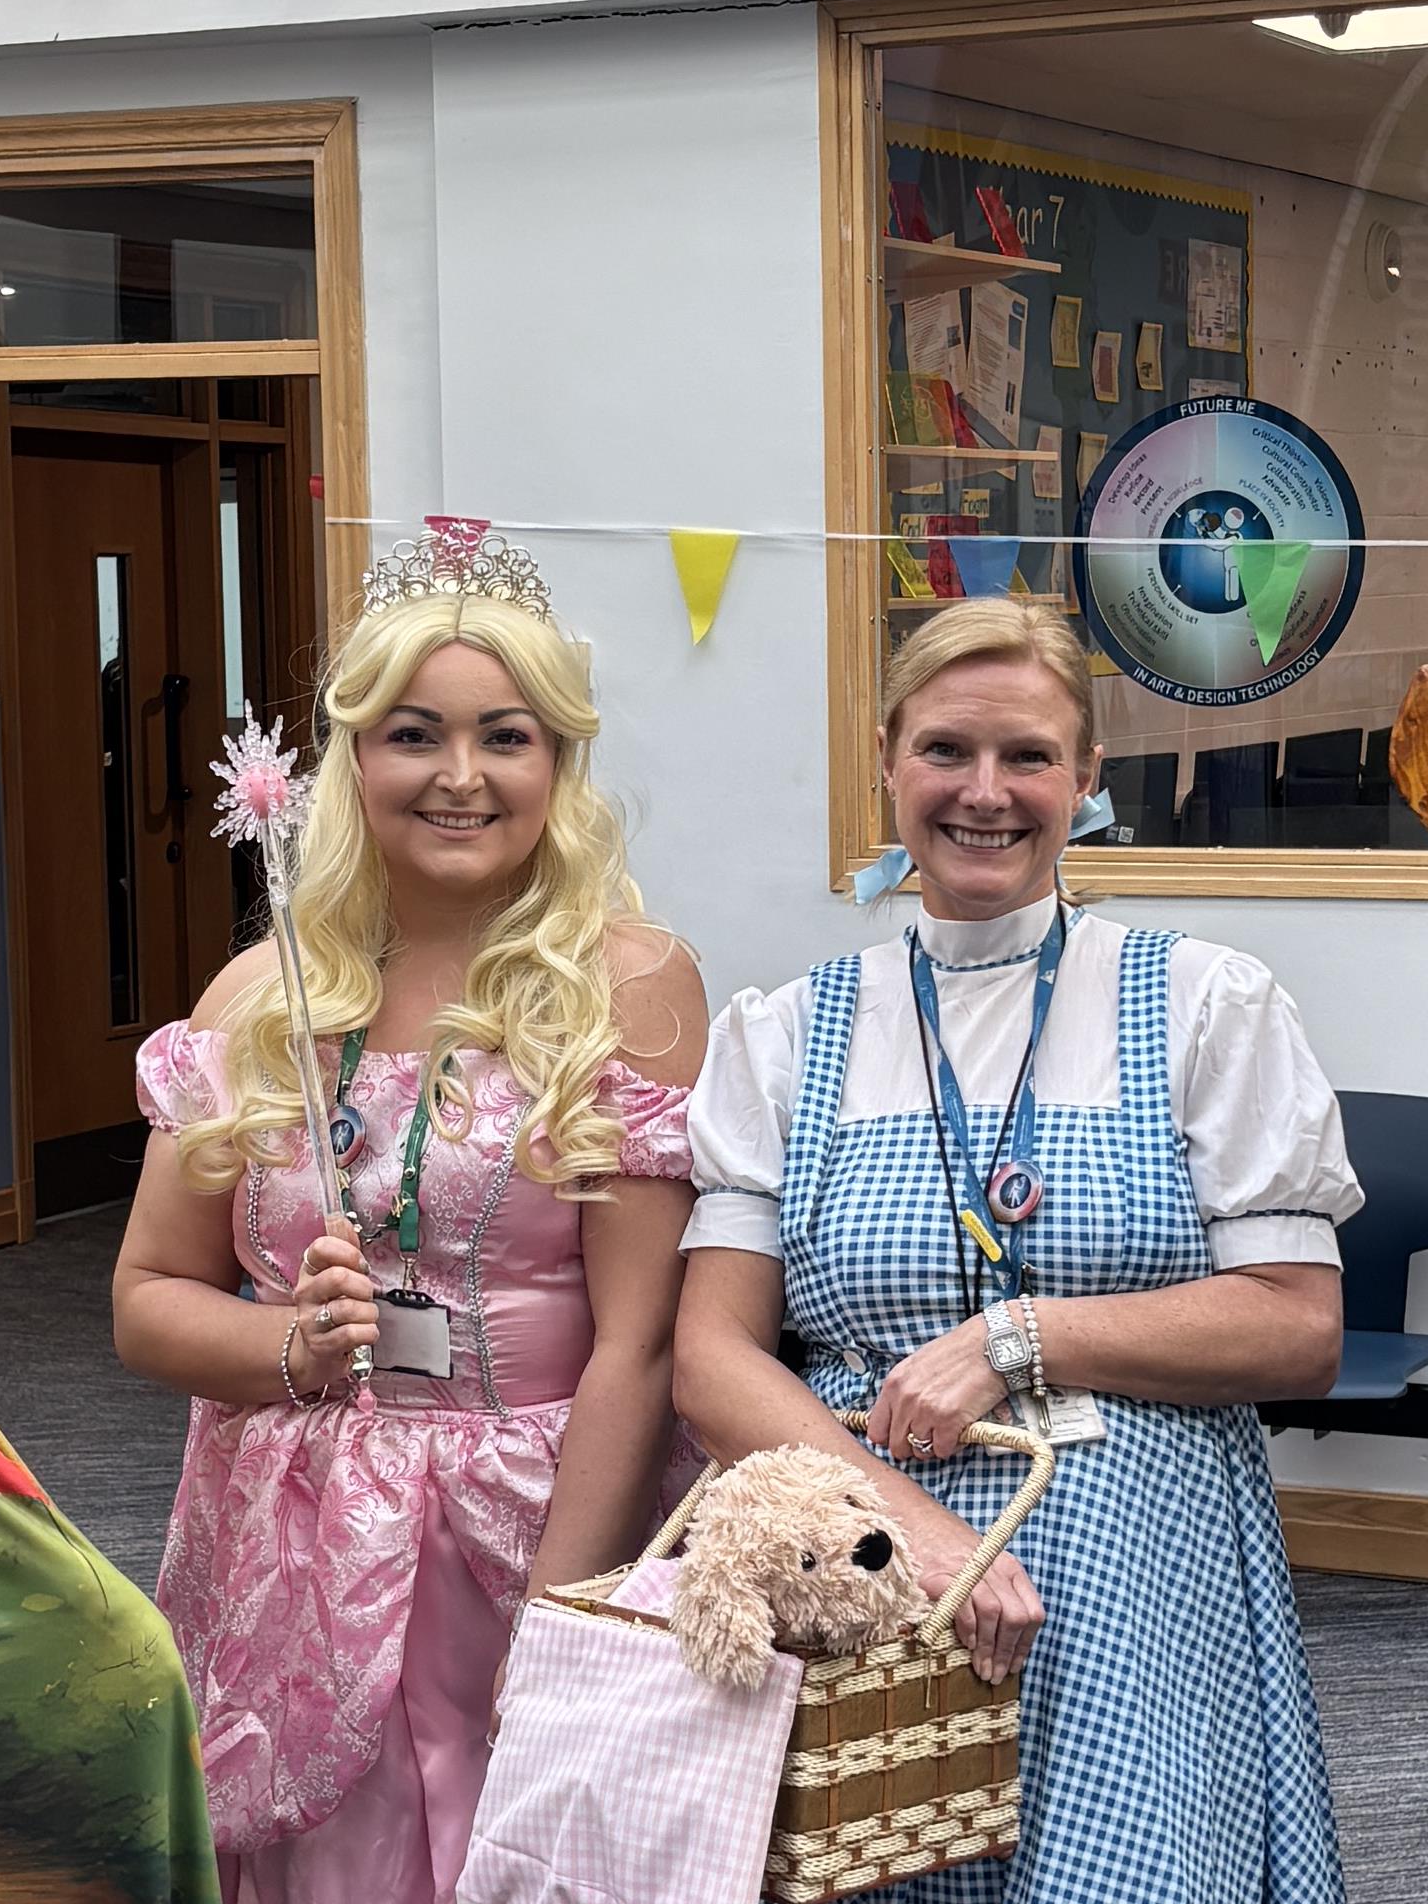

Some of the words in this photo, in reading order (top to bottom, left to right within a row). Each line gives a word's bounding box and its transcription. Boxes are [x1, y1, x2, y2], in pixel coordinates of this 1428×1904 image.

[1049, 195, 1065, 248] 7
[1179, 398, 1233, 416] FUTURE
[1236, 401, 1256, 415] ME
[1252, 427, 1282, 448] Critical
[1280, 441, 1309, 468] Thinker
[1107, 474, 1132, 505] Develop
[1129, 453, 1148, 476] Ideas
[1132, 478, 1155, 507] Record
[1261, 446, 1290, 474] Cultural
[1288, 469, 1321, 513] Contributor
[1261, 474, 1292, 507] Advocate
[1265, 462, 1307, 511] Collaboration
[1313, 477, 1334, 518] Visionary
[1140, 486, 1165, 516] Present
[1127, 590, 1156, 634] Technical
[1137, 586, 1174, 629] Imagination
[1146, 567, 1169, 608] PERSONAL
[1185, 614, 1199, 625] SET
[1121, 603, 1158, 646] Observation
[1133, 666, 1148, 684] IN
[1146, 673, 1173, 695] ART
[1173, 686, 1185, 700] &
[1187, 688, 1237, 704] DESIGN
[1238, 647, 1323, 701] TECHNOLOGY
